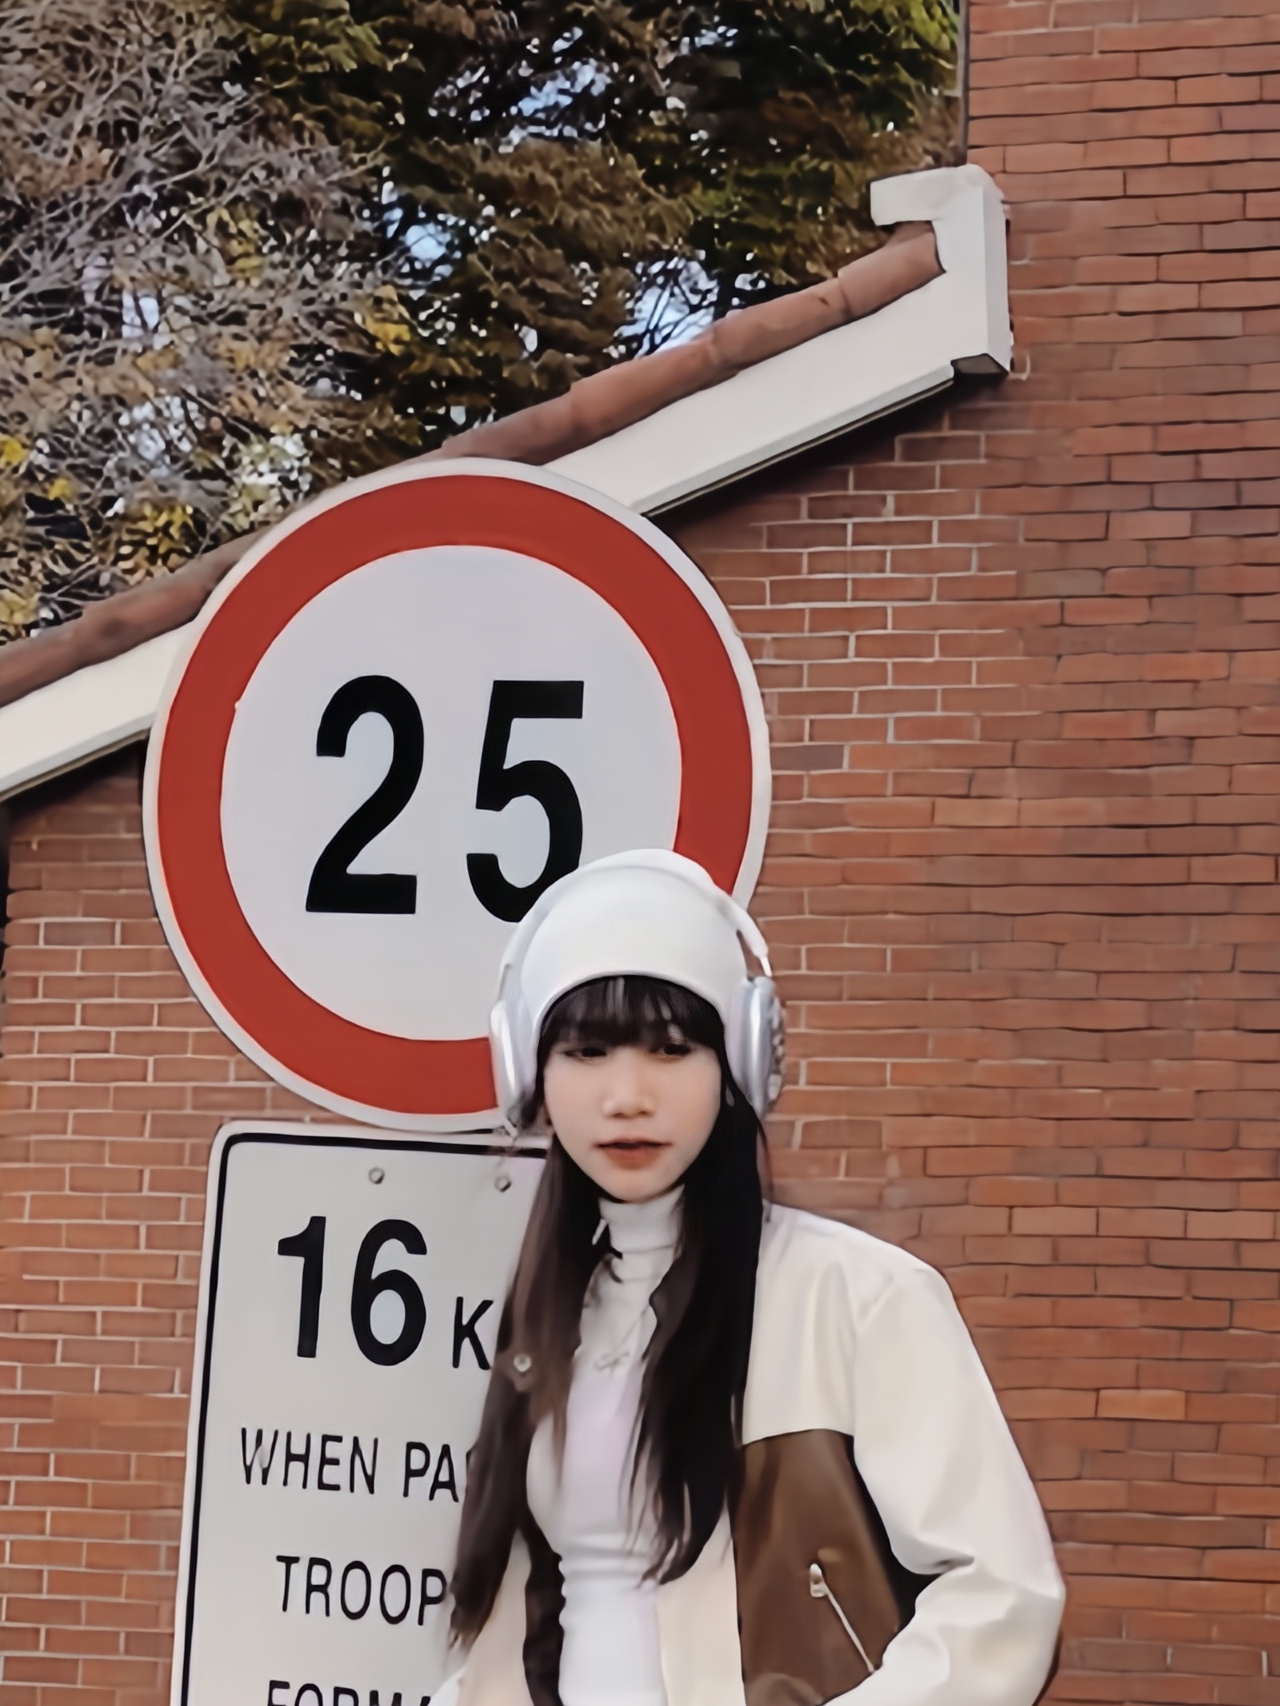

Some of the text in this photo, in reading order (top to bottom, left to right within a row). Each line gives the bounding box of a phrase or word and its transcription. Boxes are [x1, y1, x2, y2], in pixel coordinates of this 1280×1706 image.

[305, 674, 585, 924] 25
[276, 1215, 495, 1371] 16 K
[240, 1426, 476, 1504] WHEN PA
